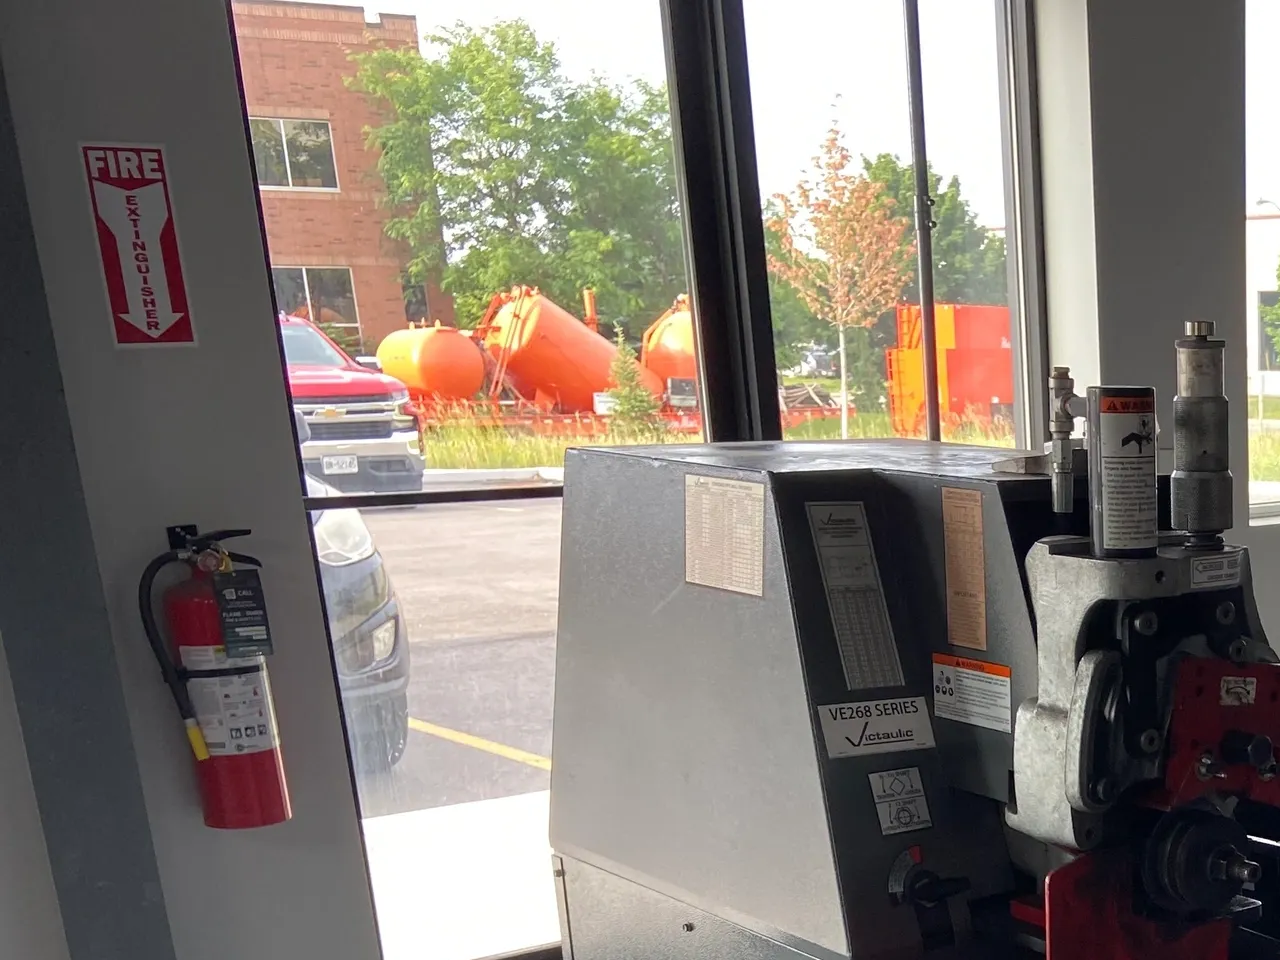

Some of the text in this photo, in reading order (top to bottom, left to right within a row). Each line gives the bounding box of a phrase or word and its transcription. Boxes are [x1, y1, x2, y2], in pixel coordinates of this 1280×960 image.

[86, 150, 162, 179] FIRE
[125, 195, 160, 330] EXTINGUISHER
[829, 705, 872, 721] VE268
[874, 700, 919, 717] SERIES
[845, 721, 914, 747] Victaulic
